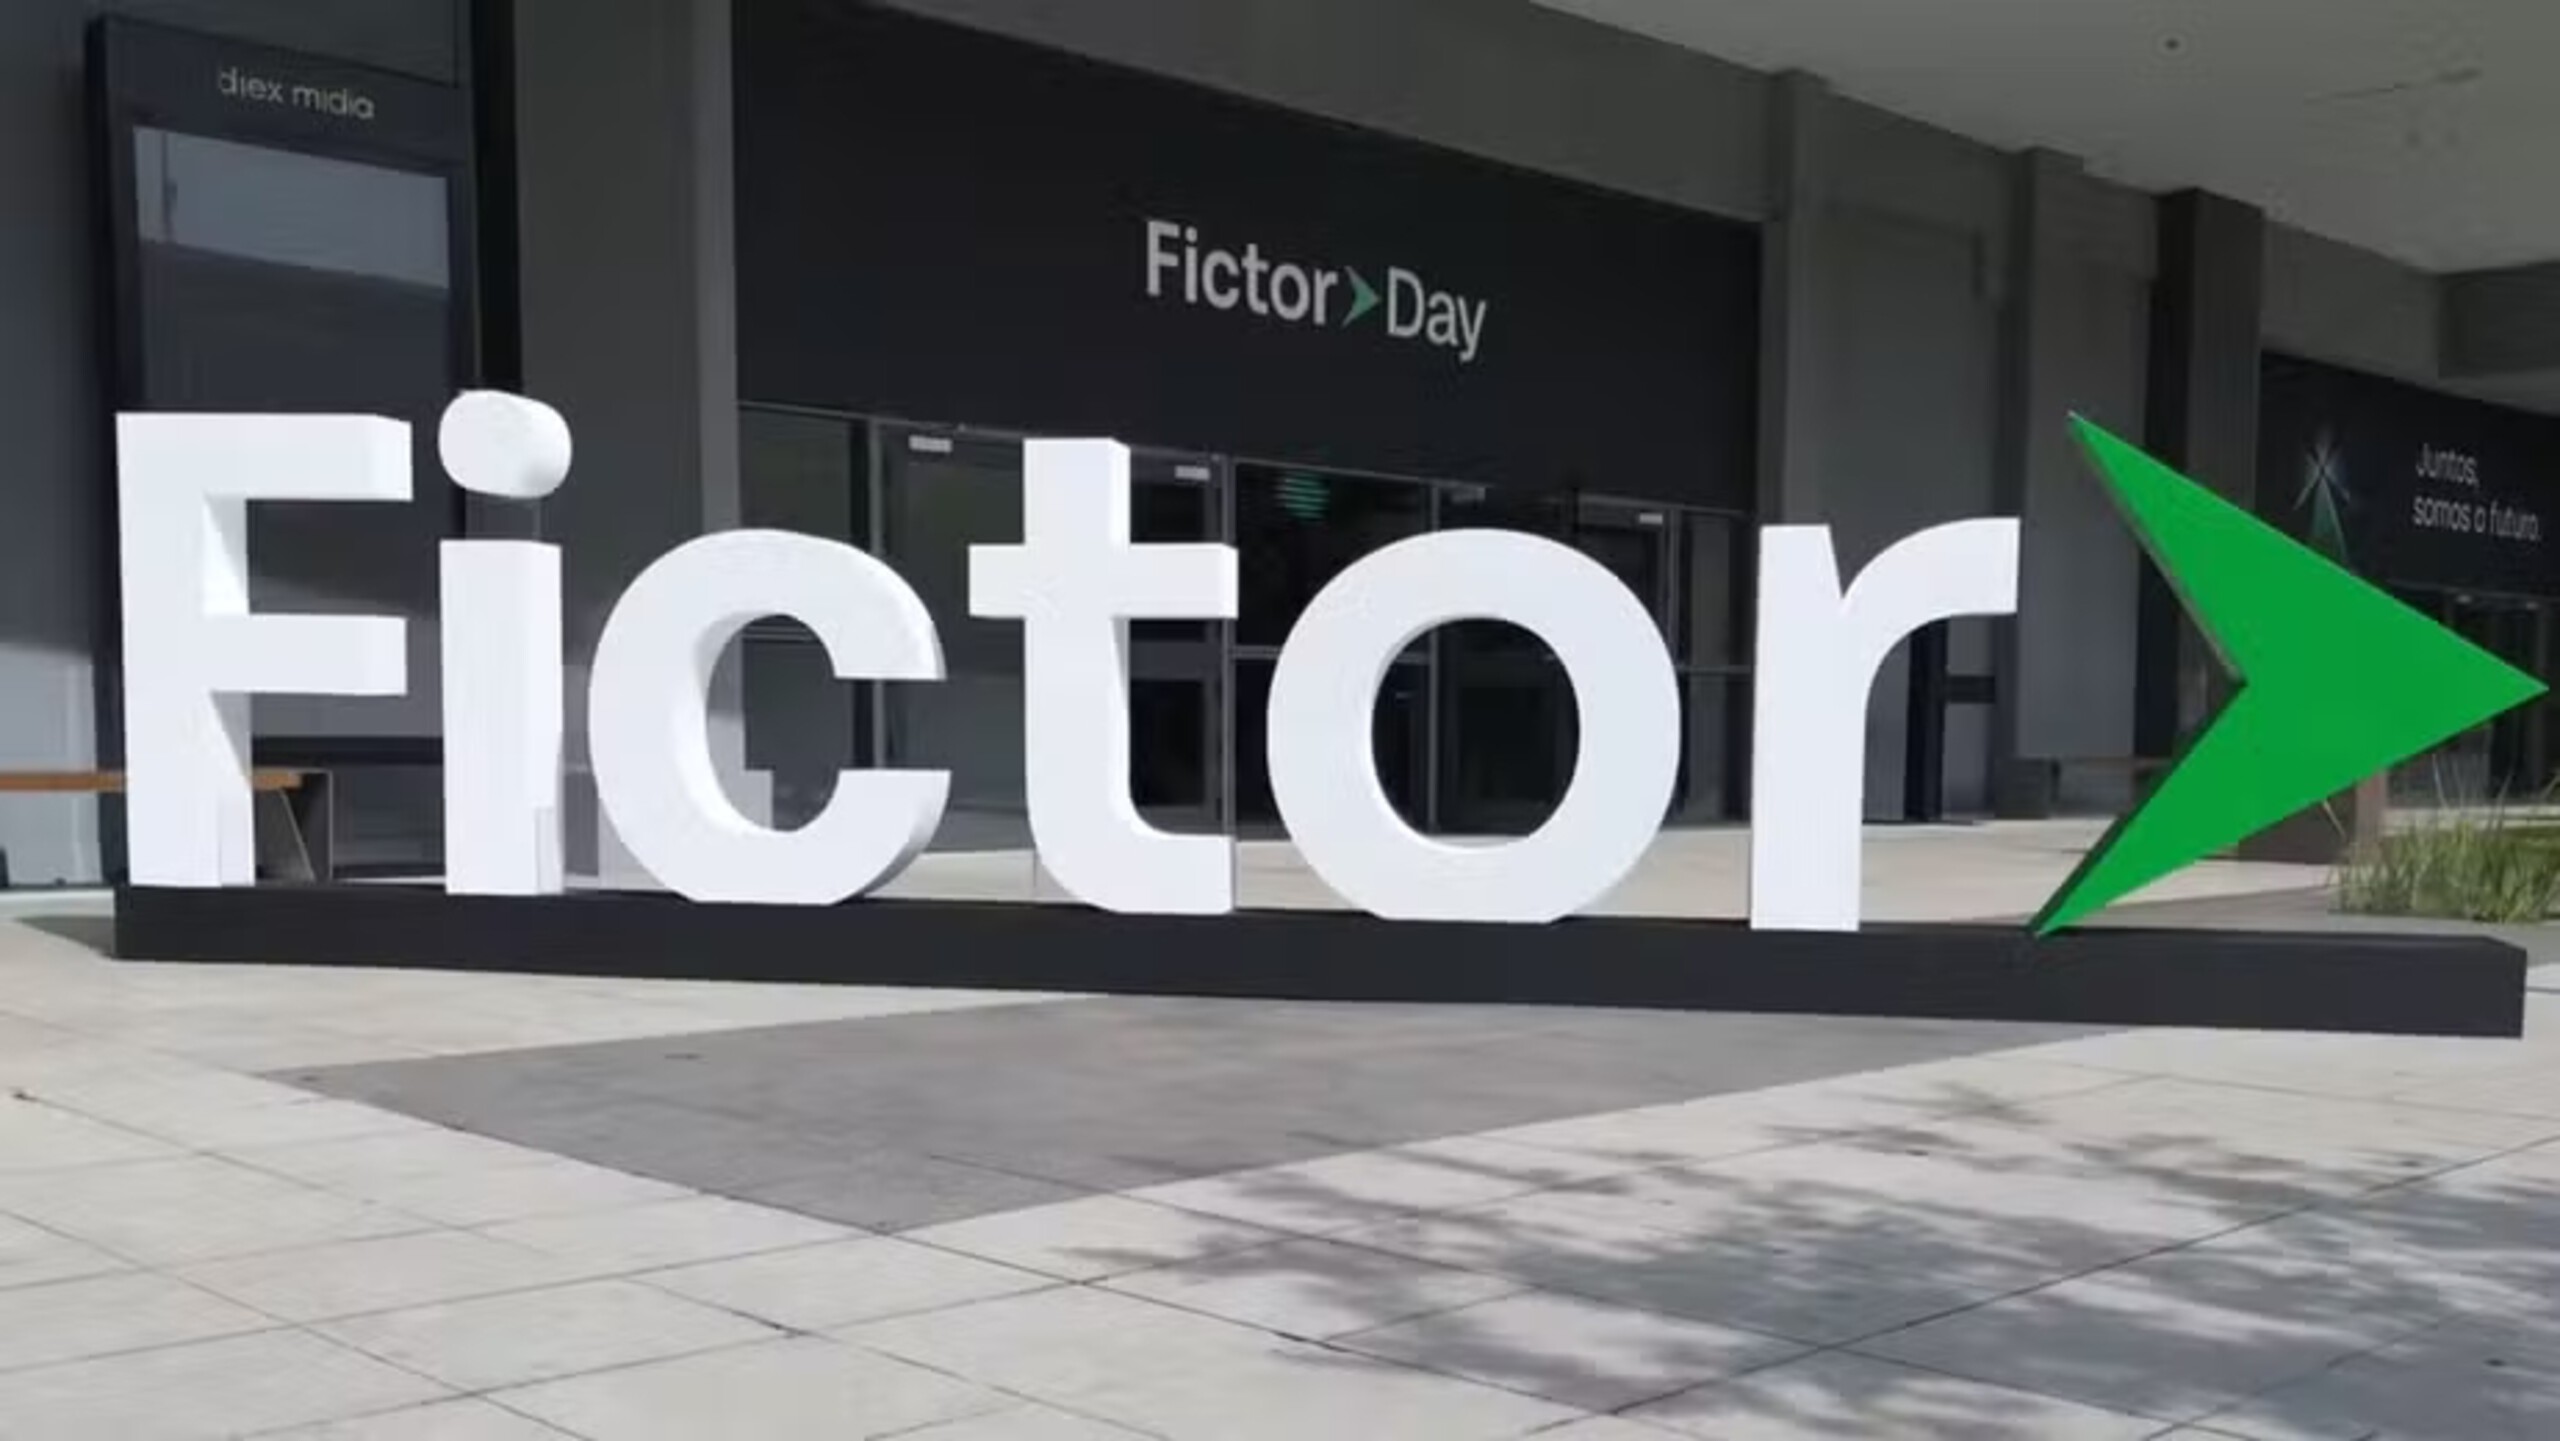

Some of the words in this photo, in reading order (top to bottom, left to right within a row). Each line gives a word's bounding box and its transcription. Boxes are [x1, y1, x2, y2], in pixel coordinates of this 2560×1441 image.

[1146, 219, 1339, 325] Fictor
[1387, 266, 1487, 362] Day
[2413, 496, 2472, 533] somos
[2474, 505, 2486, 533] o
[116, 389, 2020, 932] Fictor
